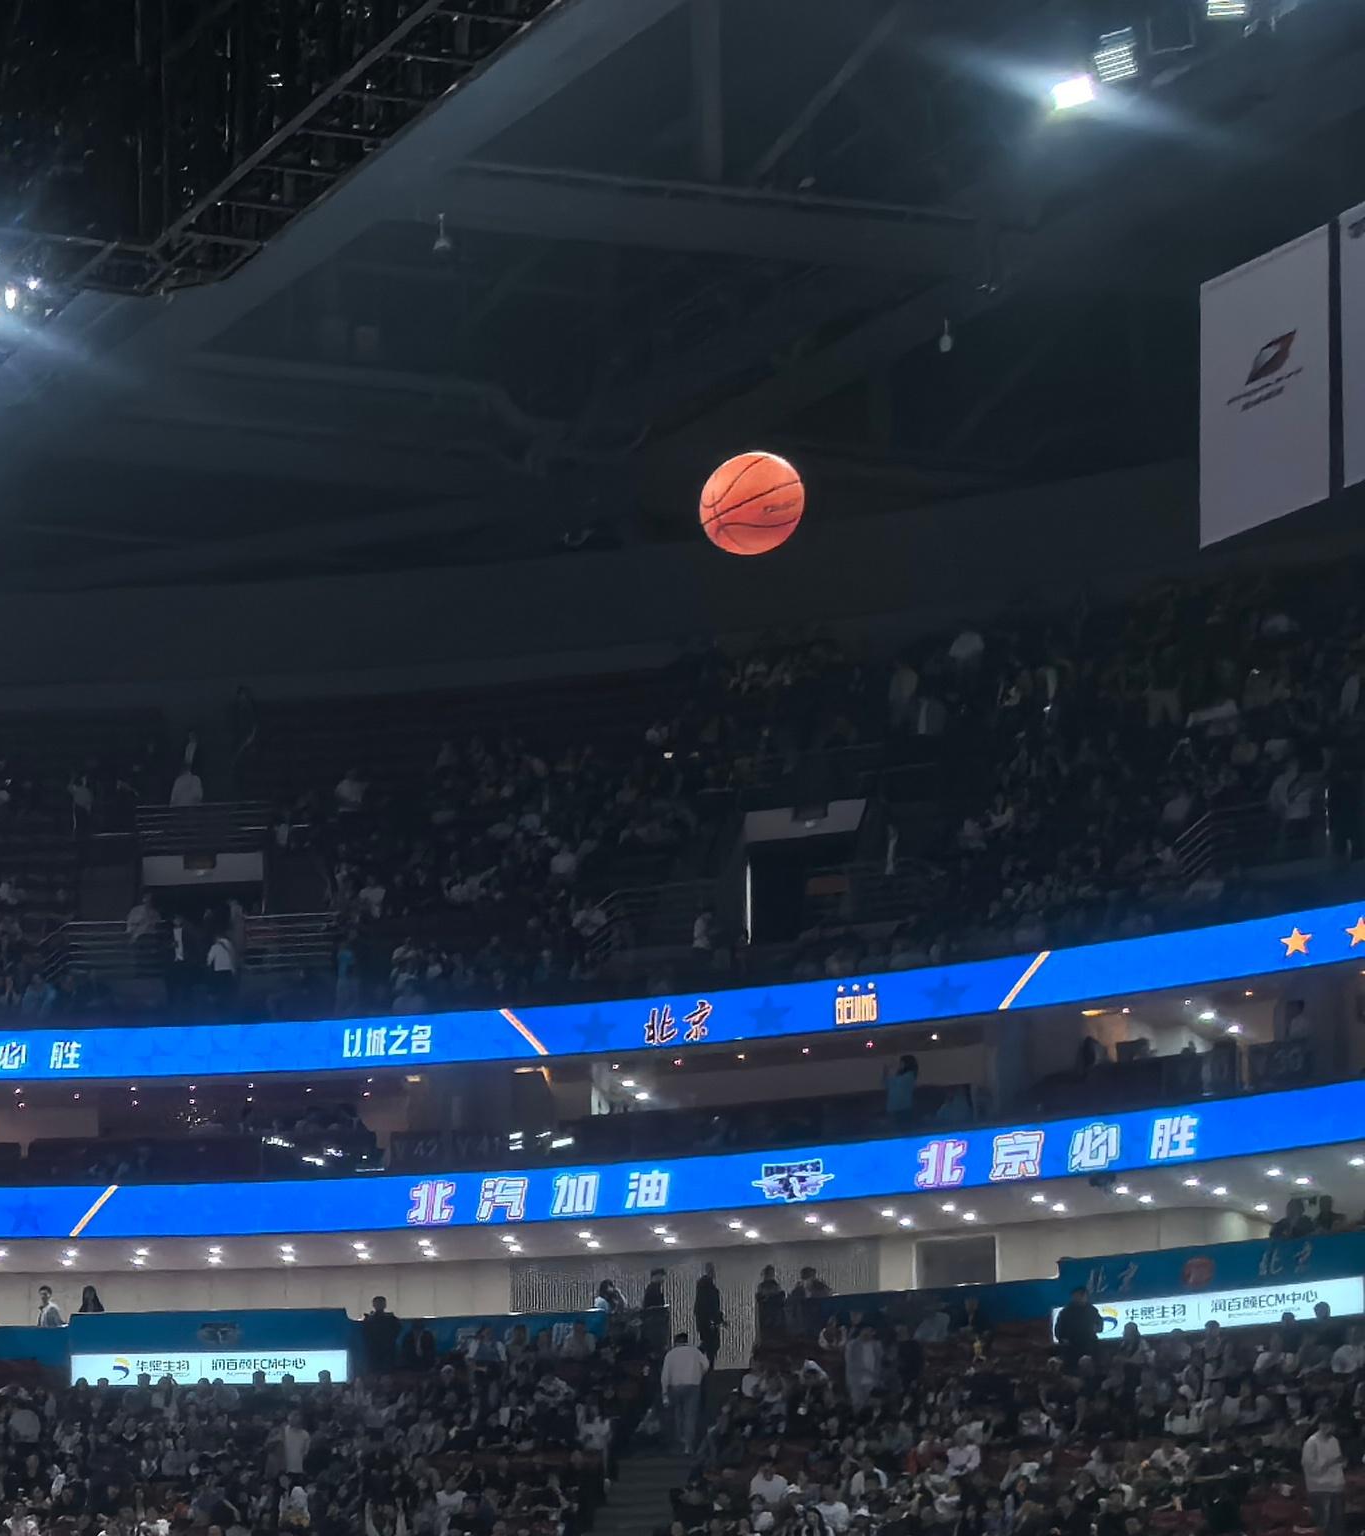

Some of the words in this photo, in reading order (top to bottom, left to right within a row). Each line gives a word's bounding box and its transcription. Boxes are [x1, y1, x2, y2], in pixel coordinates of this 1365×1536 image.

[643, 999, 713, 1047] 北京
[835, 992, 878, 1027] BEIJING
[342, 1024, 432, 1059] 以城之名
[915, 1113, 1200, 1190] 北京必胜
[405, 1170, 671, 1225] 北汽加油
